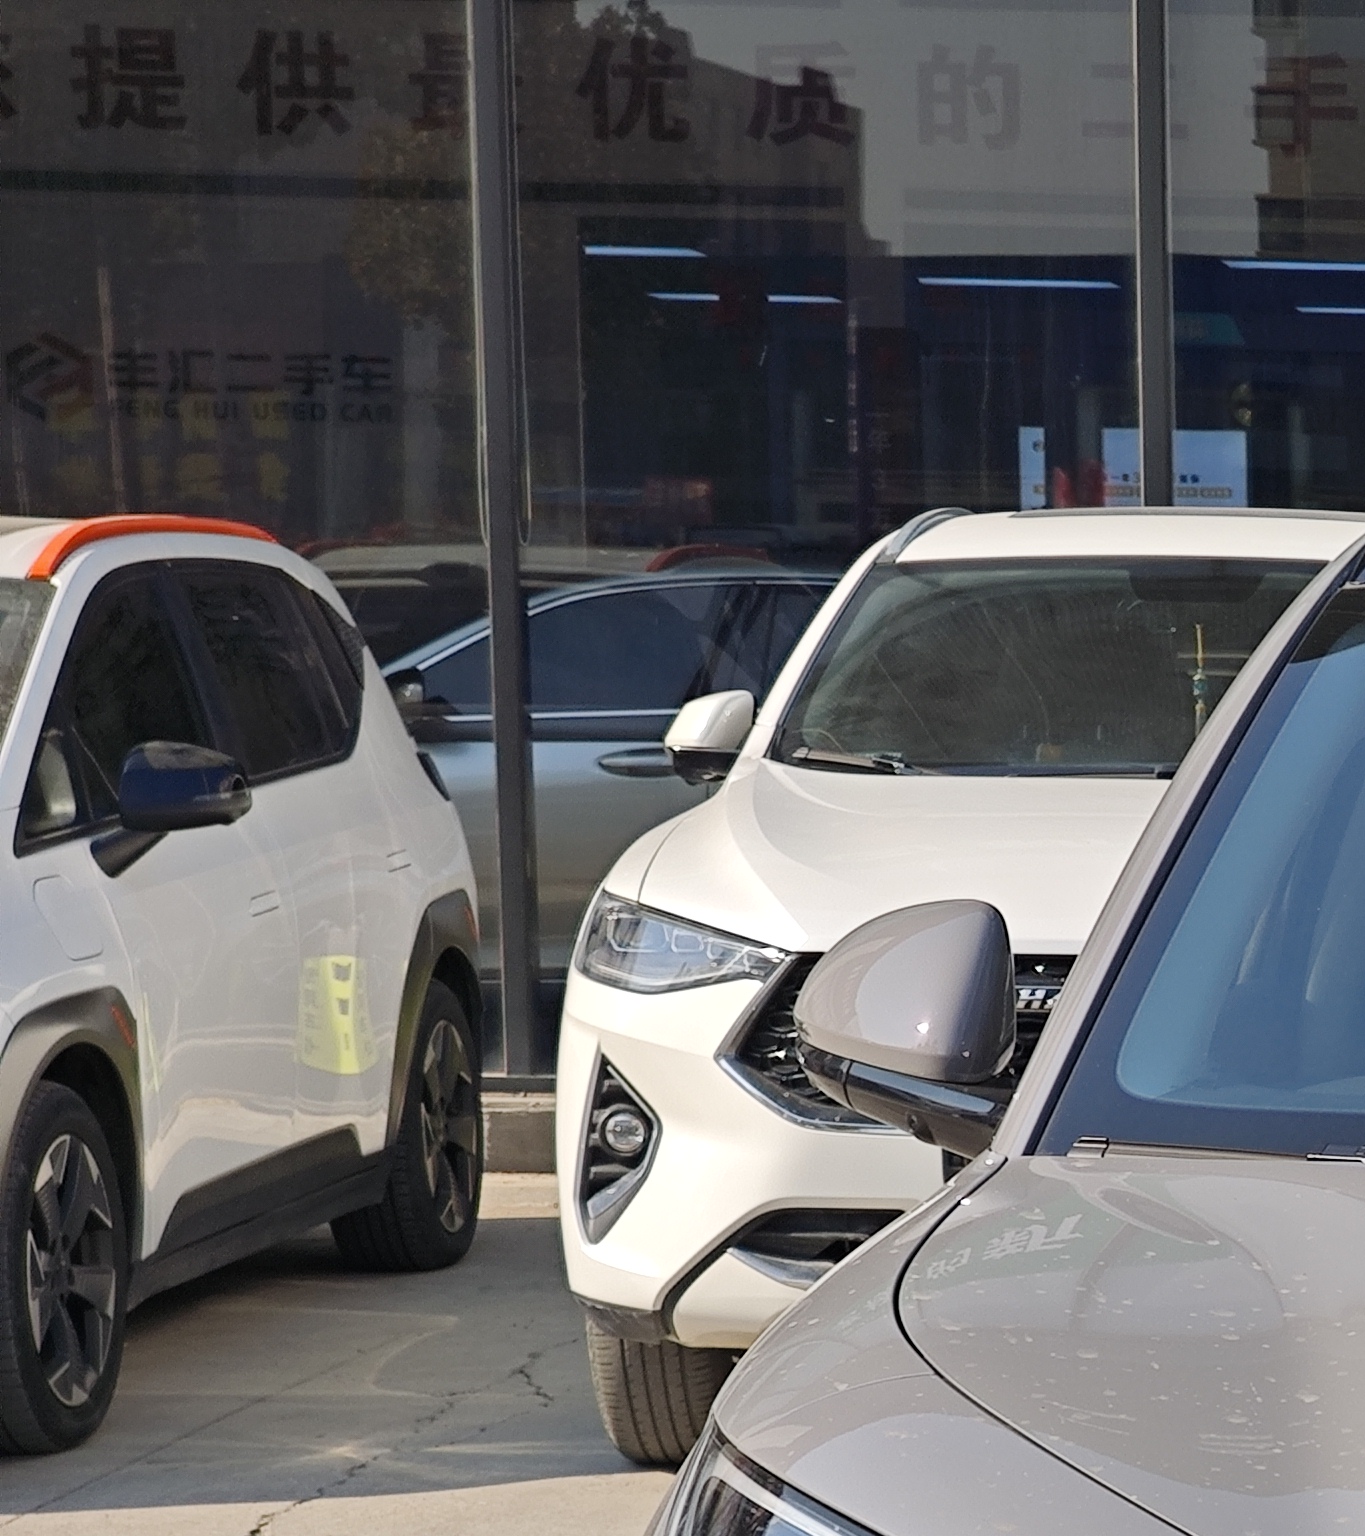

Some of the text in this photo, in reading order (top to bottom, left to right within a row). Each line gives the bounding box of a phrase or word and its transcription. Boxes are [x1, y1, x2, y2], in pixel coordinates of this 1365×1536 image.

[113, 352, 392, 394] 丰汇二手车
[193, 399, 239, 420] HUI
[253, 399, 328, 421] USED
[339, 400, 393, 422] CAR
